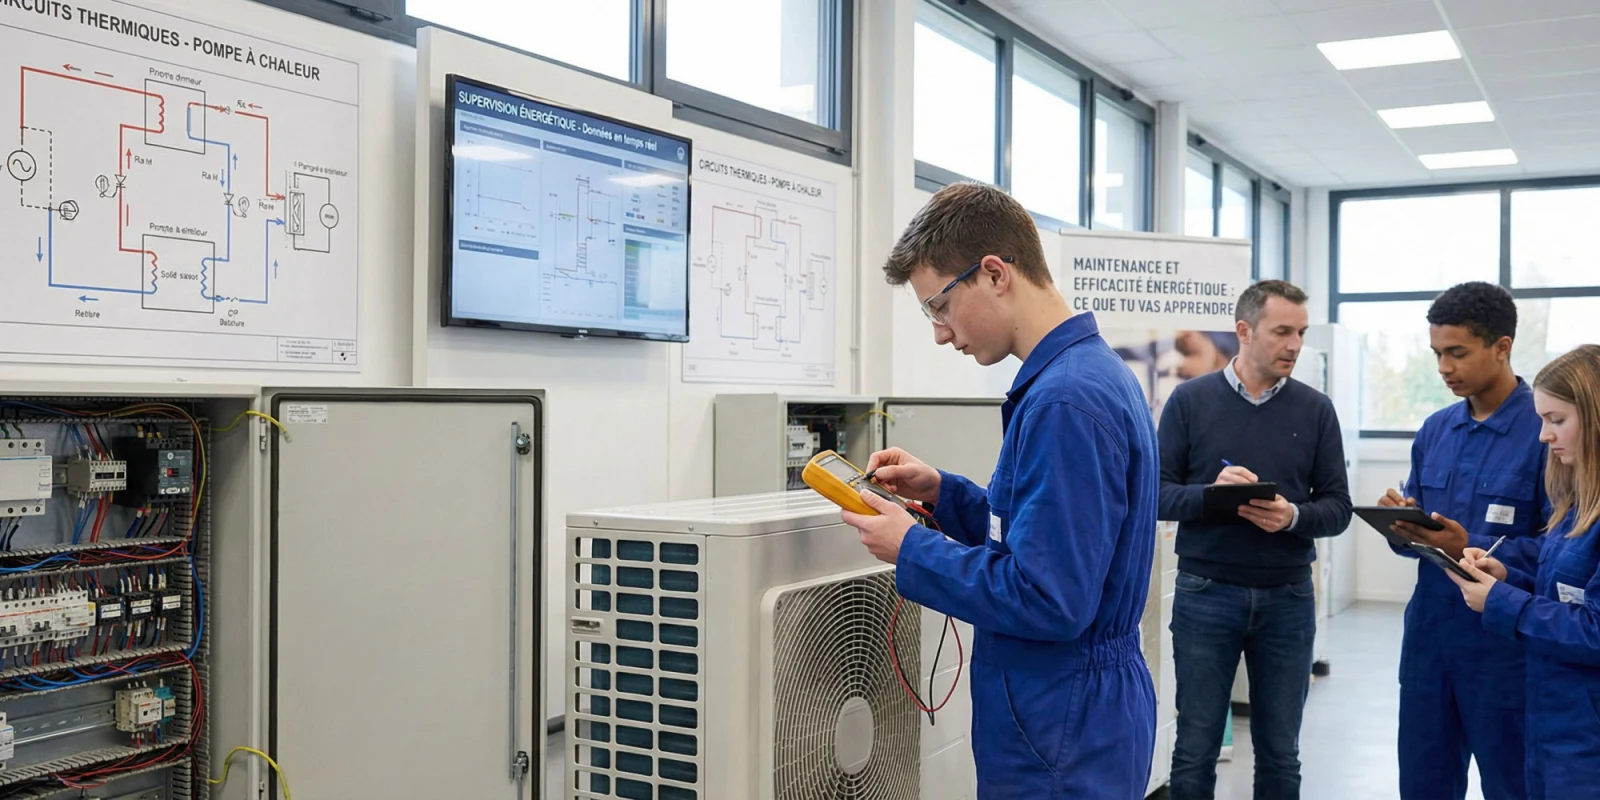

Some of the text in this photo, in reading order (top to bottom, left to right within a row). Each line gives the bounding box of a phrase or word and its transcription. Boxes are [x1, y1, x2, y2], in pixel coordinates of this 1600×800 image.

[77, 8, 180, 47] THERMIQUES
[193, 37, 242, 62] POMPE
[246, 47, 256, 65] À
[259, 54, 320, 81] CHALEUR
[458, 91, 518, 117] SUPERVISION
[519, 104, 577, 132] ÉNERGÉTIQUE
[582, 122, 612, 141] Données
[614, 133, 623, 143] en
[624, 134, 644, 150] temps
[645, 139, 658, 152] réel
[699, 159, 728, 175] CIRCUITS
[1074, 257, 1180, 275] MAINTENANCE ET
[1074, 276, 1143, 293] EFFICACITÉ
[1146, 277, 1227, 296] ÉNERGÉTIQUE
[1074, 297, 1234, 315] CE QUE TU VAS APPRENDRE
